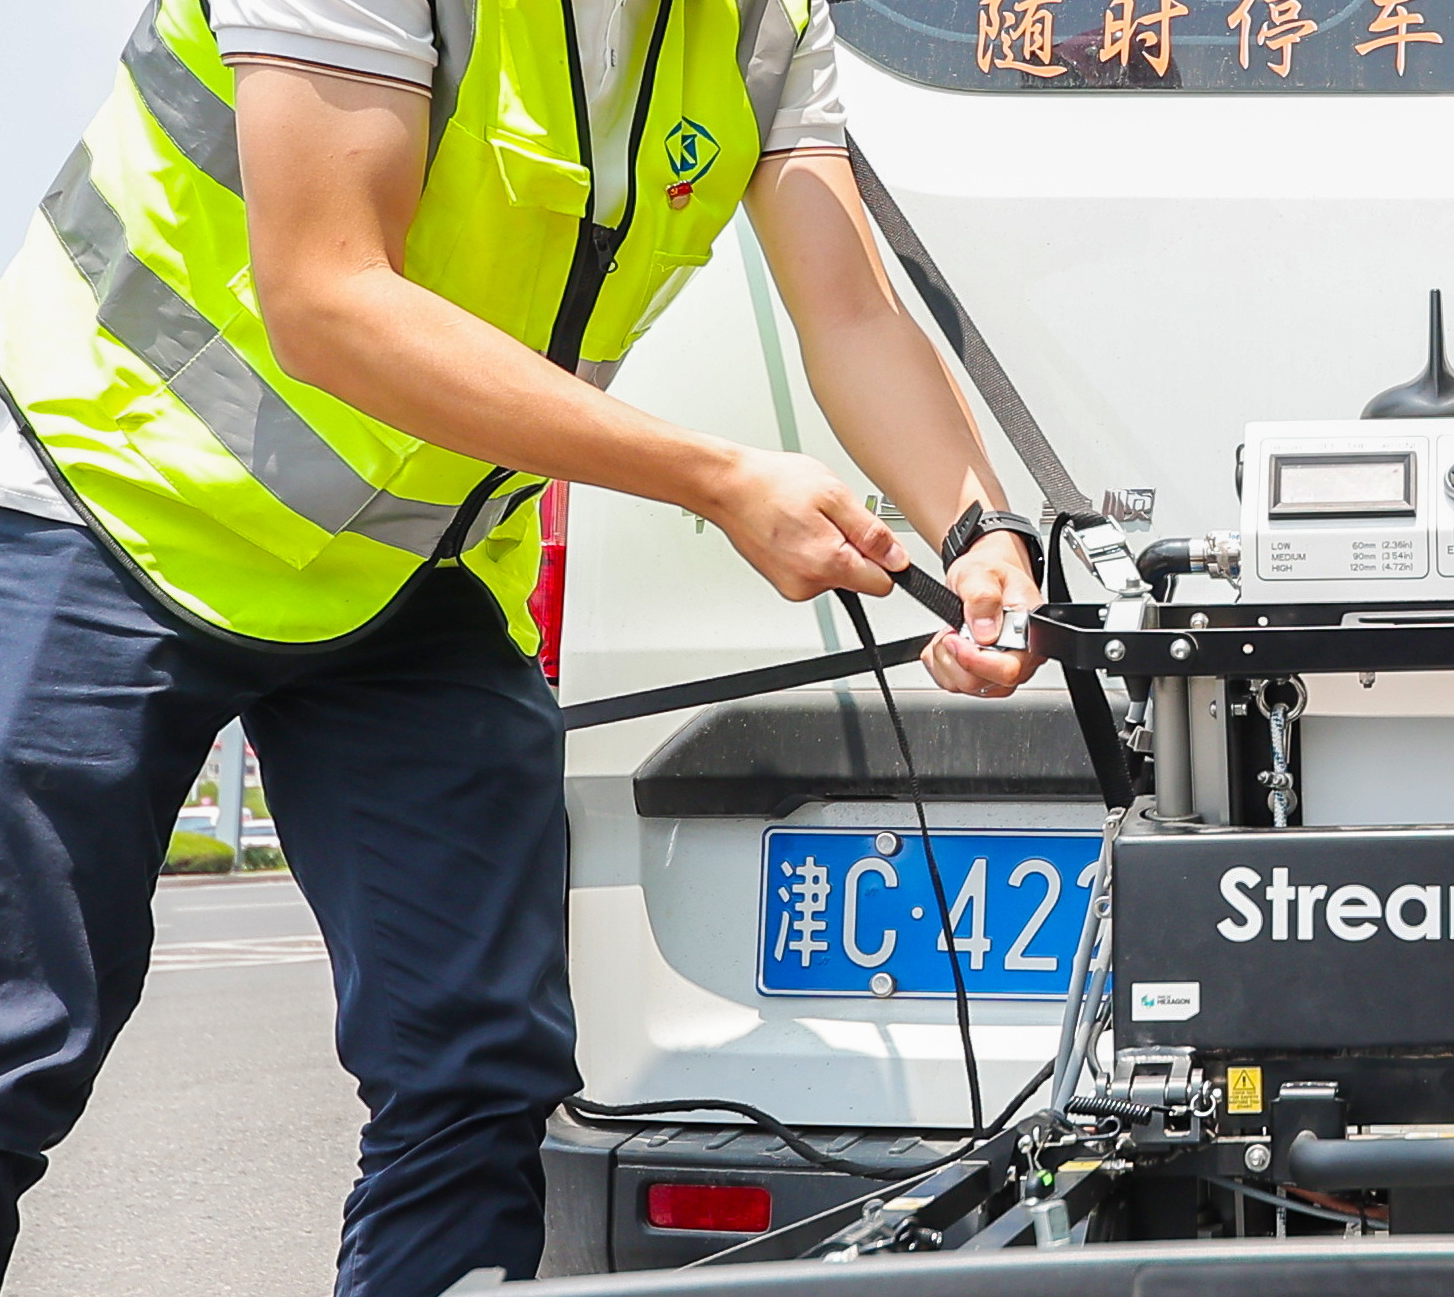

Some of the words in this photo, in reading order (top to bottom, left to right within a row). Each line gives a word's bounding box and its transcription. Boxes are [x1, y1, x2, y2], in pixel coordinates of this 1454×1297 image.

[1271, 542, 1291, 551] LOW
[1352, 541, 1376, 550] 60mm
[1381, 541, 1413, 550] (2.36in)
[1271, 553, 1306, 561] MEDIUM
[1353, 552, 1376, 561] 90mm
[1271, 564, 1293, 572] HIGH
[1350, 563, 1377, 572] 120mm
[1381, 563, 1413, 572] (4.72in)
